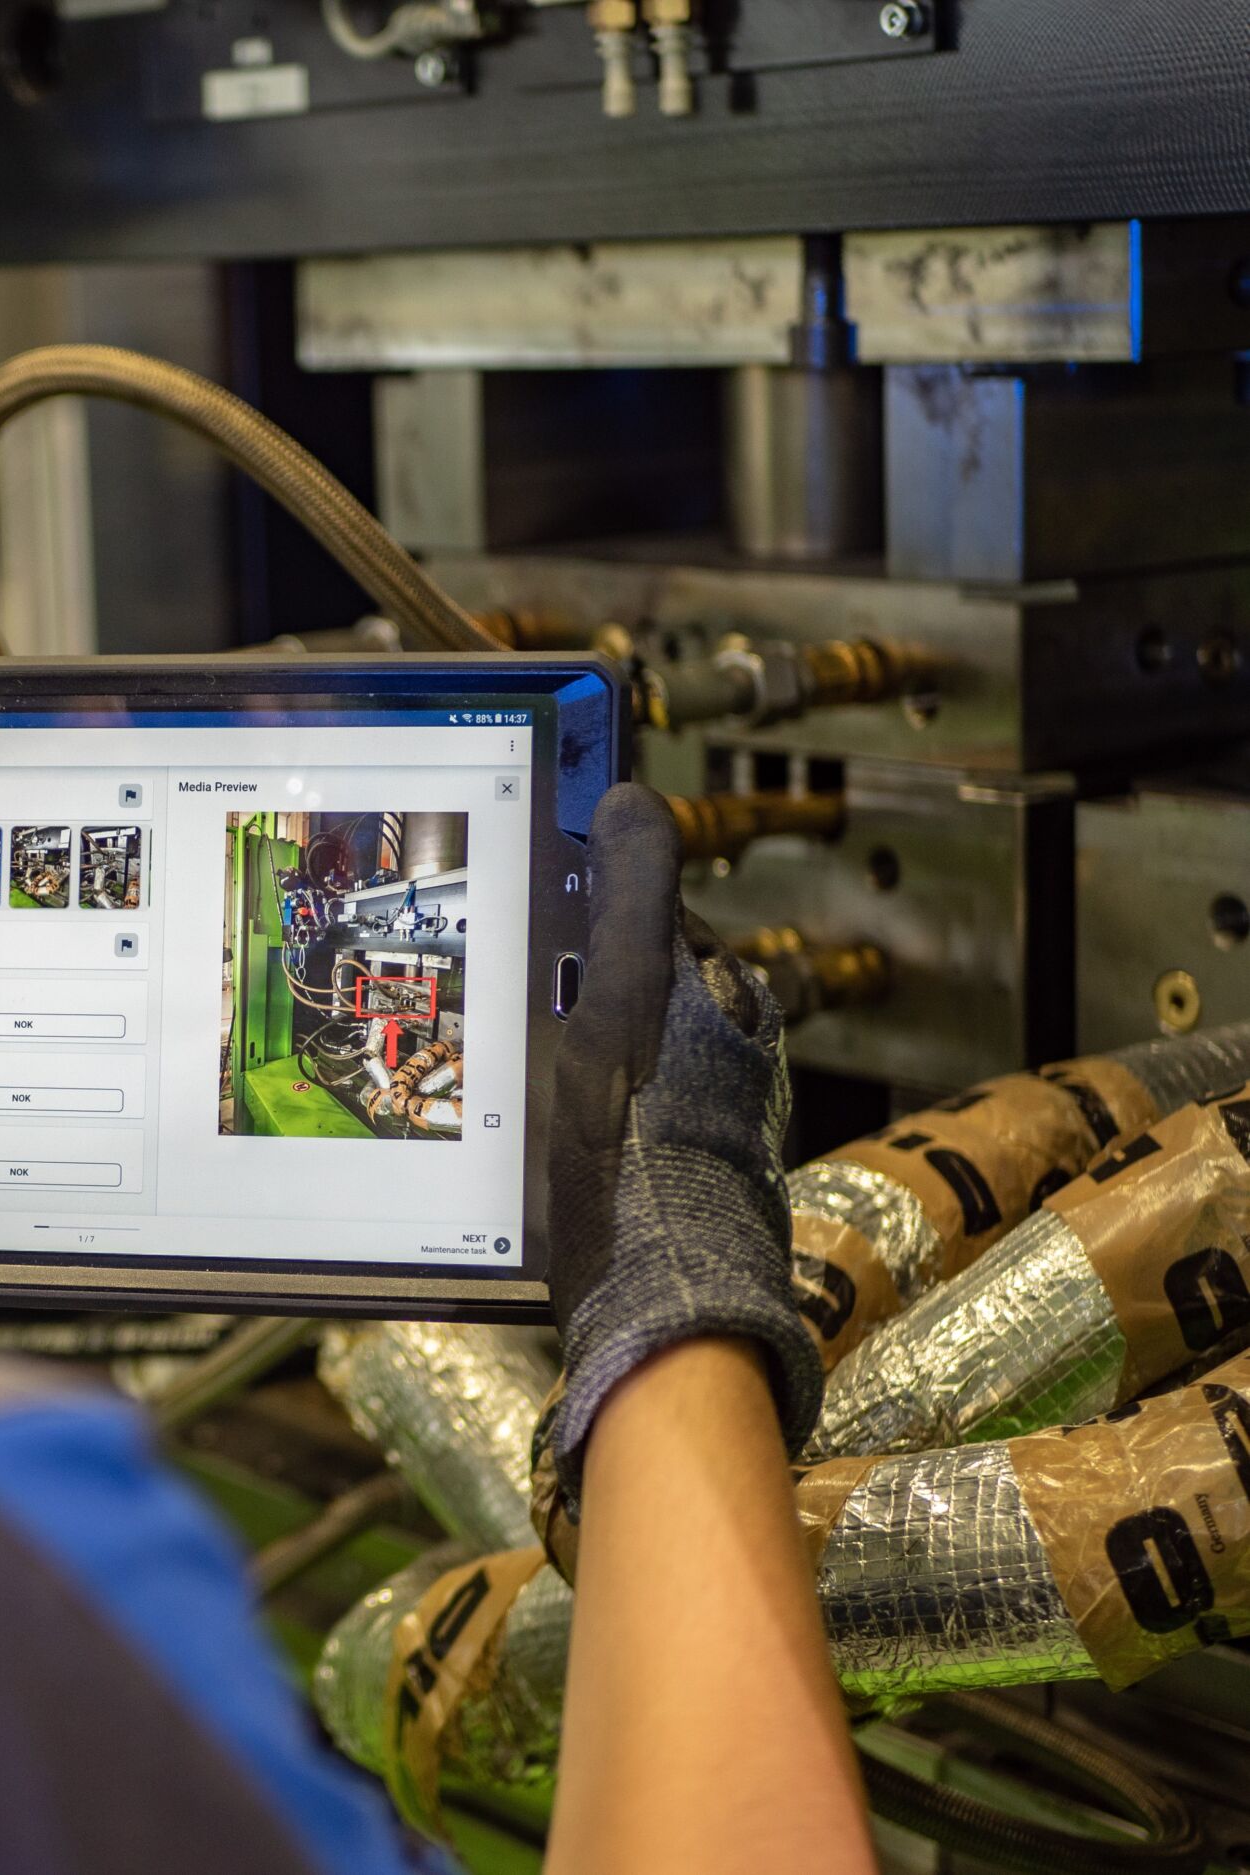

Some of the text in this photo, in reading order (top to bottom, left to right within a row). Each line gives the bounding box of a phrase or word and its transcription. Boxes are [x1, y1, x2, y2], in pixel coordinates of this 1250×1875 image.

[476, 713, 528, 724] 88% 14:37
[178, 781, 258, 793] Media Preview
[13, 1020, 34, 1029] NOK
[11, 1093, 31, 1103] NOK
[9, 1167, 29, 1177] NOK
[462, 1234, 487, 1243] NEXT
[420, 1245, 487, 1255] Maintenance task
[1194, 1493, 1226, 1555] Germany
